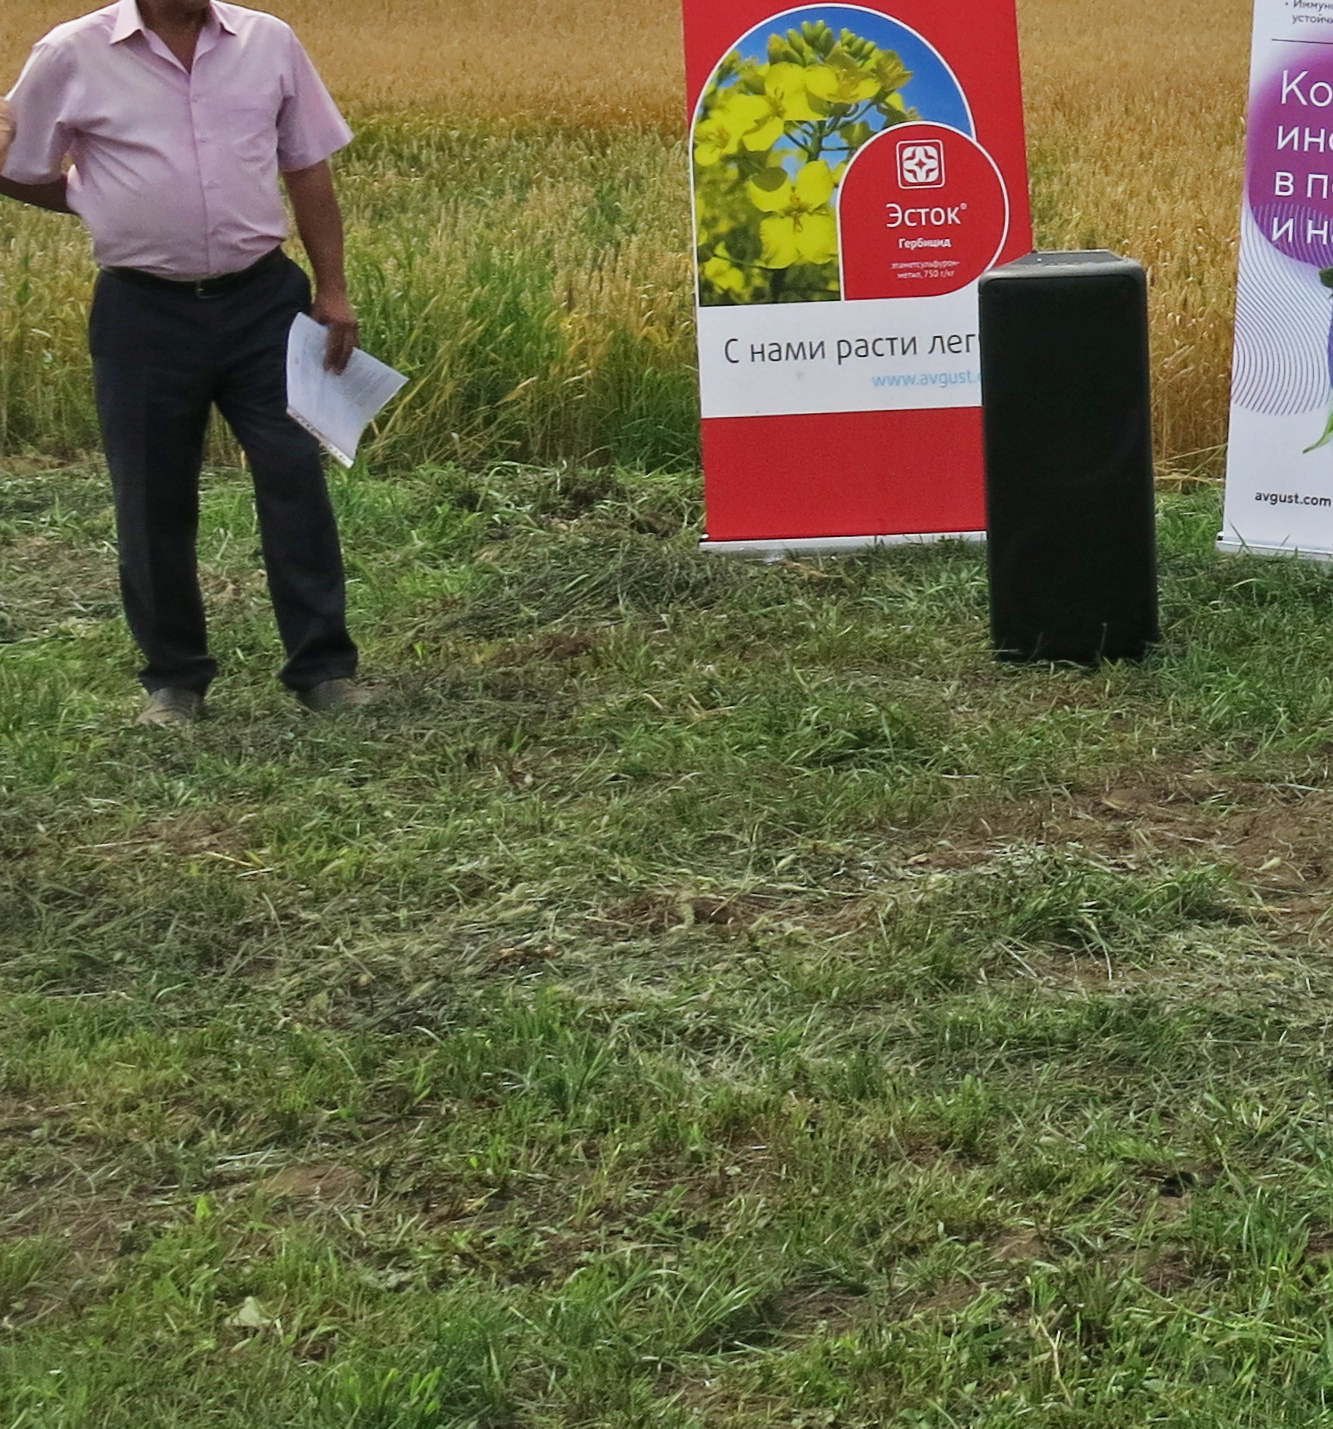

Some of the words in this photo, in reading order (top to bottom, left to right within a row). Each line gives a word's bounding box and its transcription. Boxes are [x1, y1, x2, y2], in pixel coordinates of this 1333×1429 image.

[1274, 175, 1294, 197] в
[1271, 219, 1294, 243] и
[898, 237, 952, 251] Гербицид
[724, 337, 740, 364] С
[750, 339, 826, 363] нами
[837, 335, 918, 365] расти
[928, 333, 976, 355] лег
[872, 369, 977, 389] www.avgust.
[1255, 489, 1332, 508] avgust.com
